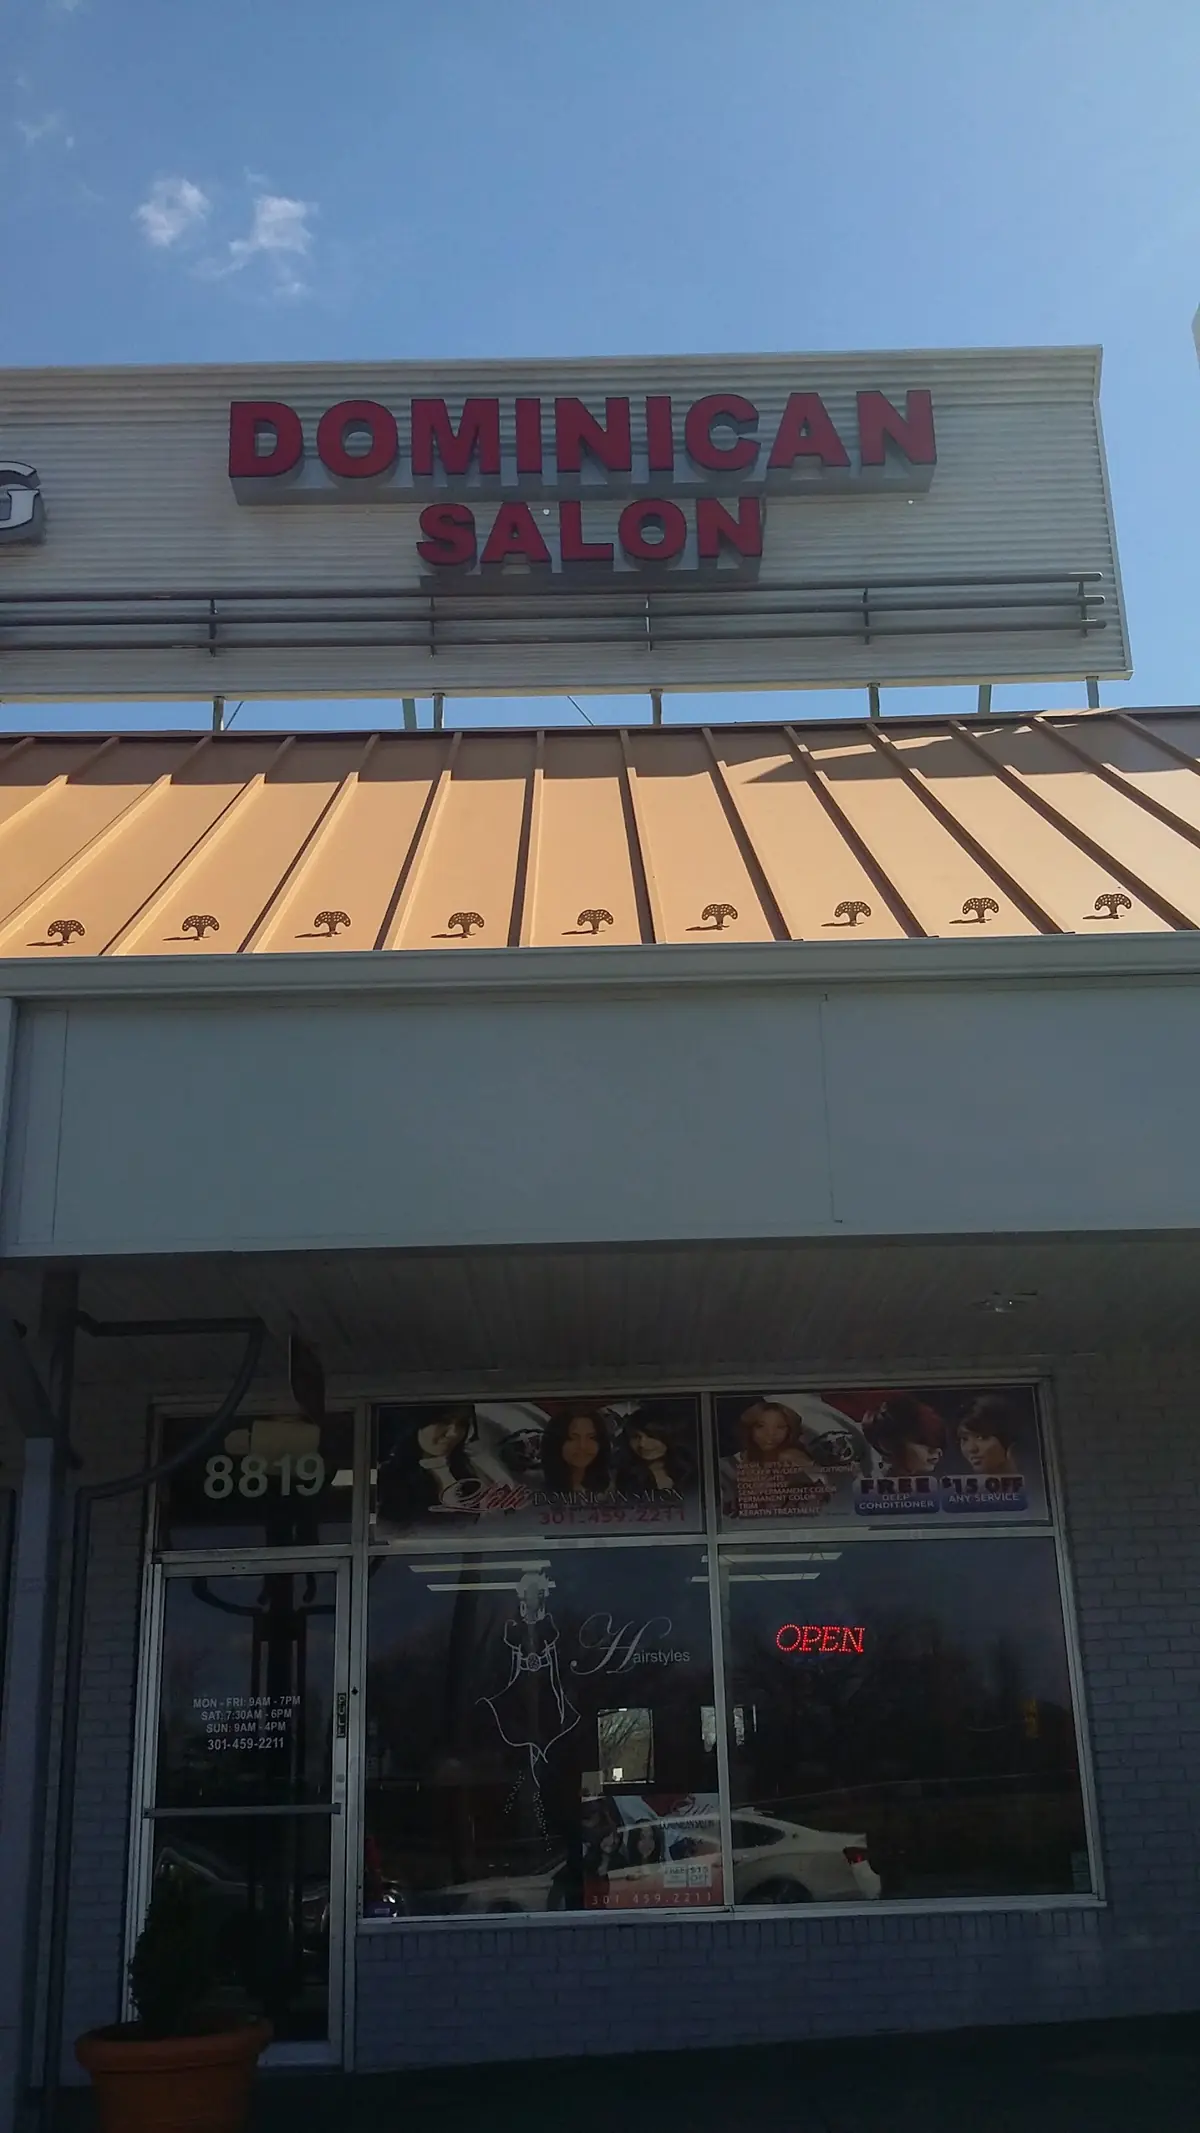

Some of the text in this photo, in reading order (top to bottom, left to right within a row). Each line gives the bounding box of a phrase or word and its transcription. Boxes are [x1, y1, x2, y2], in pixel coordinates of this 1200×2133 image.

[228, 388, 937, 479] DOMINICAN
[415, 497, 763, 567] SALON
[203, 1453, 326, 1500] 8819
[860, 1477, 931, 1495] FREE
[942, 1475, 1023, 1494] $15 OFF
[858, 1499, 935, 1510] CONDITIONER
[949, 1492, 1019, 1503] ANY SERVICE
[776, 1623, 866, 1653] OPEN
[193, 1698, 218, 1708] MON
[249, 1697, 271, 1706] 9AM
[280, 1696, 301, 1705] 7PM
[226, 1710, 262, 1720] 7:30AM
[271, 1709, 292, 1718] 6PM
[206, 1723, 232, 1733] SUN:
[234, 1722, 256, 1732] 9AM
[264, 1721, 286, 1731] 4PM
[207, 1737, 284, 1750] 301-459-2211
